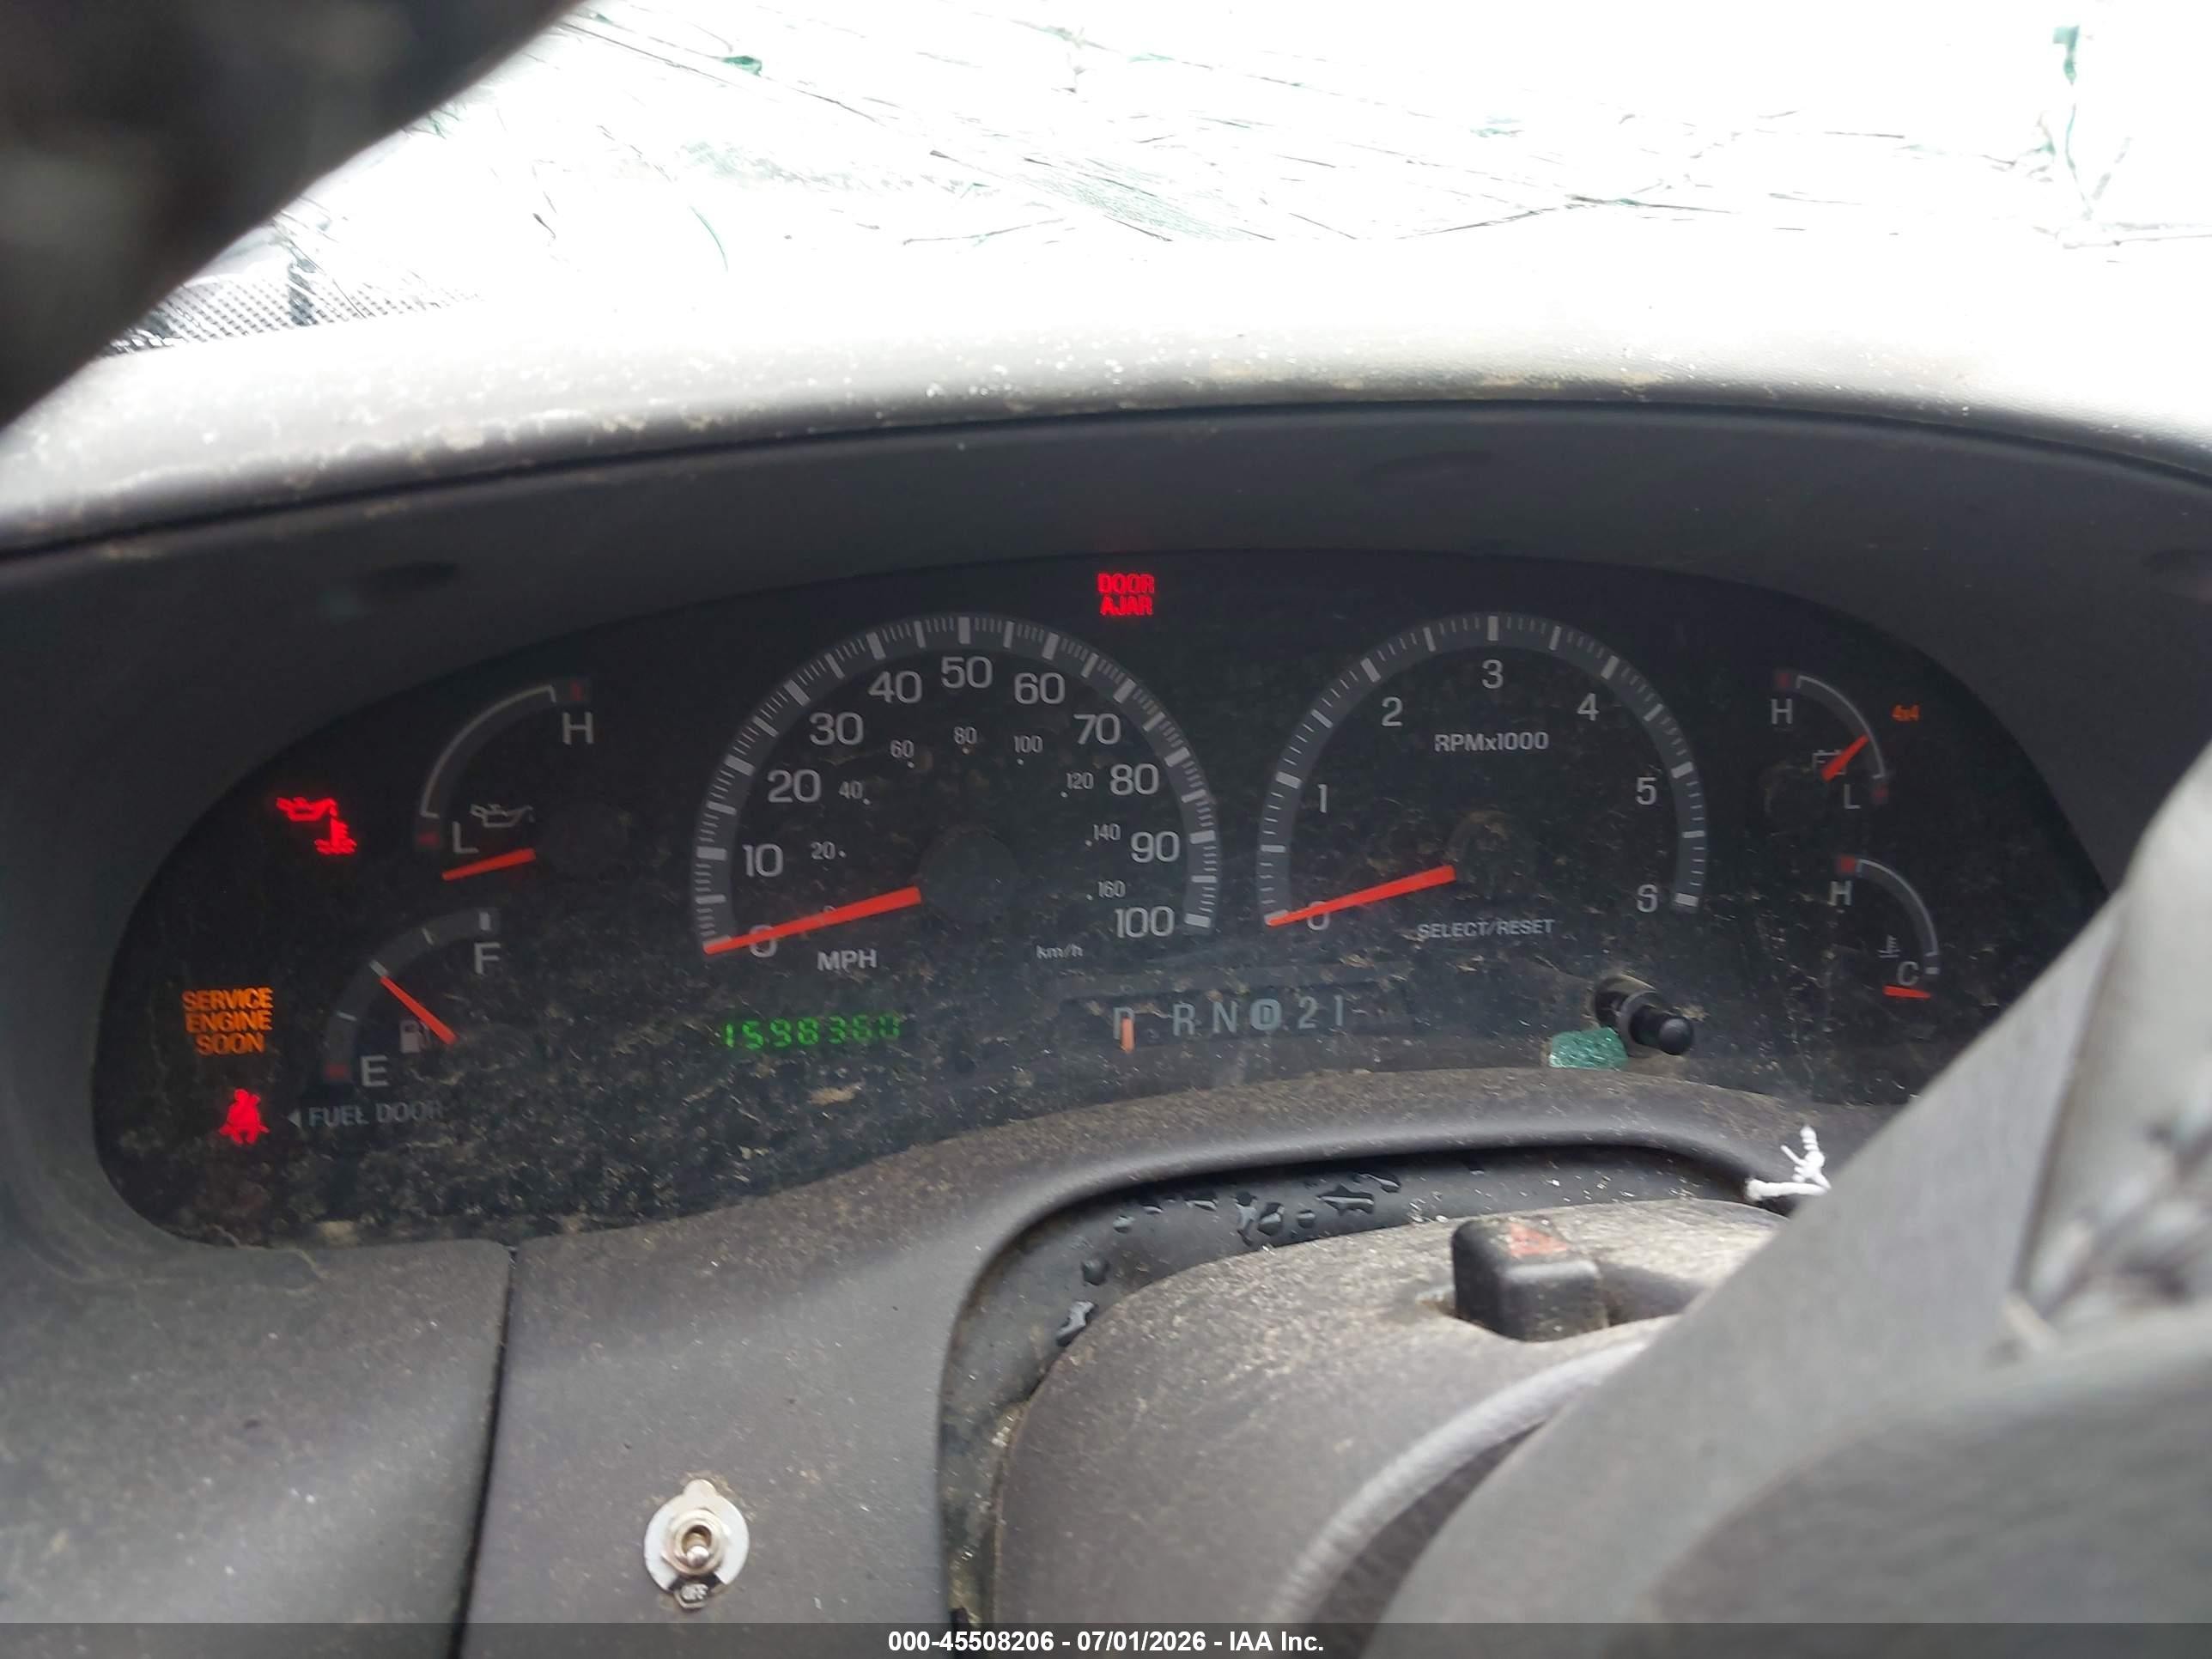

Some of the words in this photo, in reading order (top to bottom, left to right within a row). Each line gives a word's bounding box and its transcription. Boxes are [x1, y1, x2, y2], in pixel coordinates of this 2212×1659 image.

[1097, 573, 1155, 594] DOOR
[1099, 595, 1155, 617] AJAR
[940, 655, 994, 689] 50
[1480, 659, 1504, 690] 3
[867, 671, 923, 704] 40
[1013, 672, 1066, 706] 60
[1381, 696, 1404, 728] 2
[1577, 692, 1600, 721] 4
[1770, 698, 1794, 725] H
[562, 712, 594, 745] H
[809, 712, 865, 746] 30
[953, 726, 977, 744] 80
[1073, 712, 1121, 745] 70
[1433, 730, 1550, 753] RPMx1000
[890, 739, 915, 759] 60
[1013, 735, 1043, 754] 100
[767, 769, 822, 804] 20
[839, 781, 864, 799] 40
[1066, 771, 1095, 791] 120
[1109, 763, 1160, 796] 80
[1636, 775, 1656, 805] 5
[1316, 783, 1328, 814] 1
[1844, 783, 1862, 810] L
[452, 821, 479, 854] L
[1093, 823, 1121, 842] 140
[743, 843, 784, 878] 10
[811, 841, 836, 860] 20
[1129, 831, 1181, 864] 90
[1097, 880, 1126, 899] 160
[1636, 883, 1659, 915] 6
[1828, 880, 1854, 907] H
[1115, 905, 1176, 938] 100
[1416, 918, 1556, 940] SELECT/RESET
[749, 924, 778, 959] 0
[1036, 943, 1084, 961] km/h
[473, 942, 501, 976] F
[817, 948, 878, 972] MPH
[1895, 960, 1920, 987] C
[181, 986, 274, 1012] SERVICE
[185, 1008, 273, 1033] ENGINE
[1171, 1001, 1197, 1037] R
[1212, 1000, 1239, 1034] N
[1297, 995, 1320, 1030] 2
[194, 1031, 267, 1056] SOON
[361, 1054, 388, 1088] E
[308, 1103, 370, 1127] FUEL
[375, 1099, 444, 1124] DOOR
